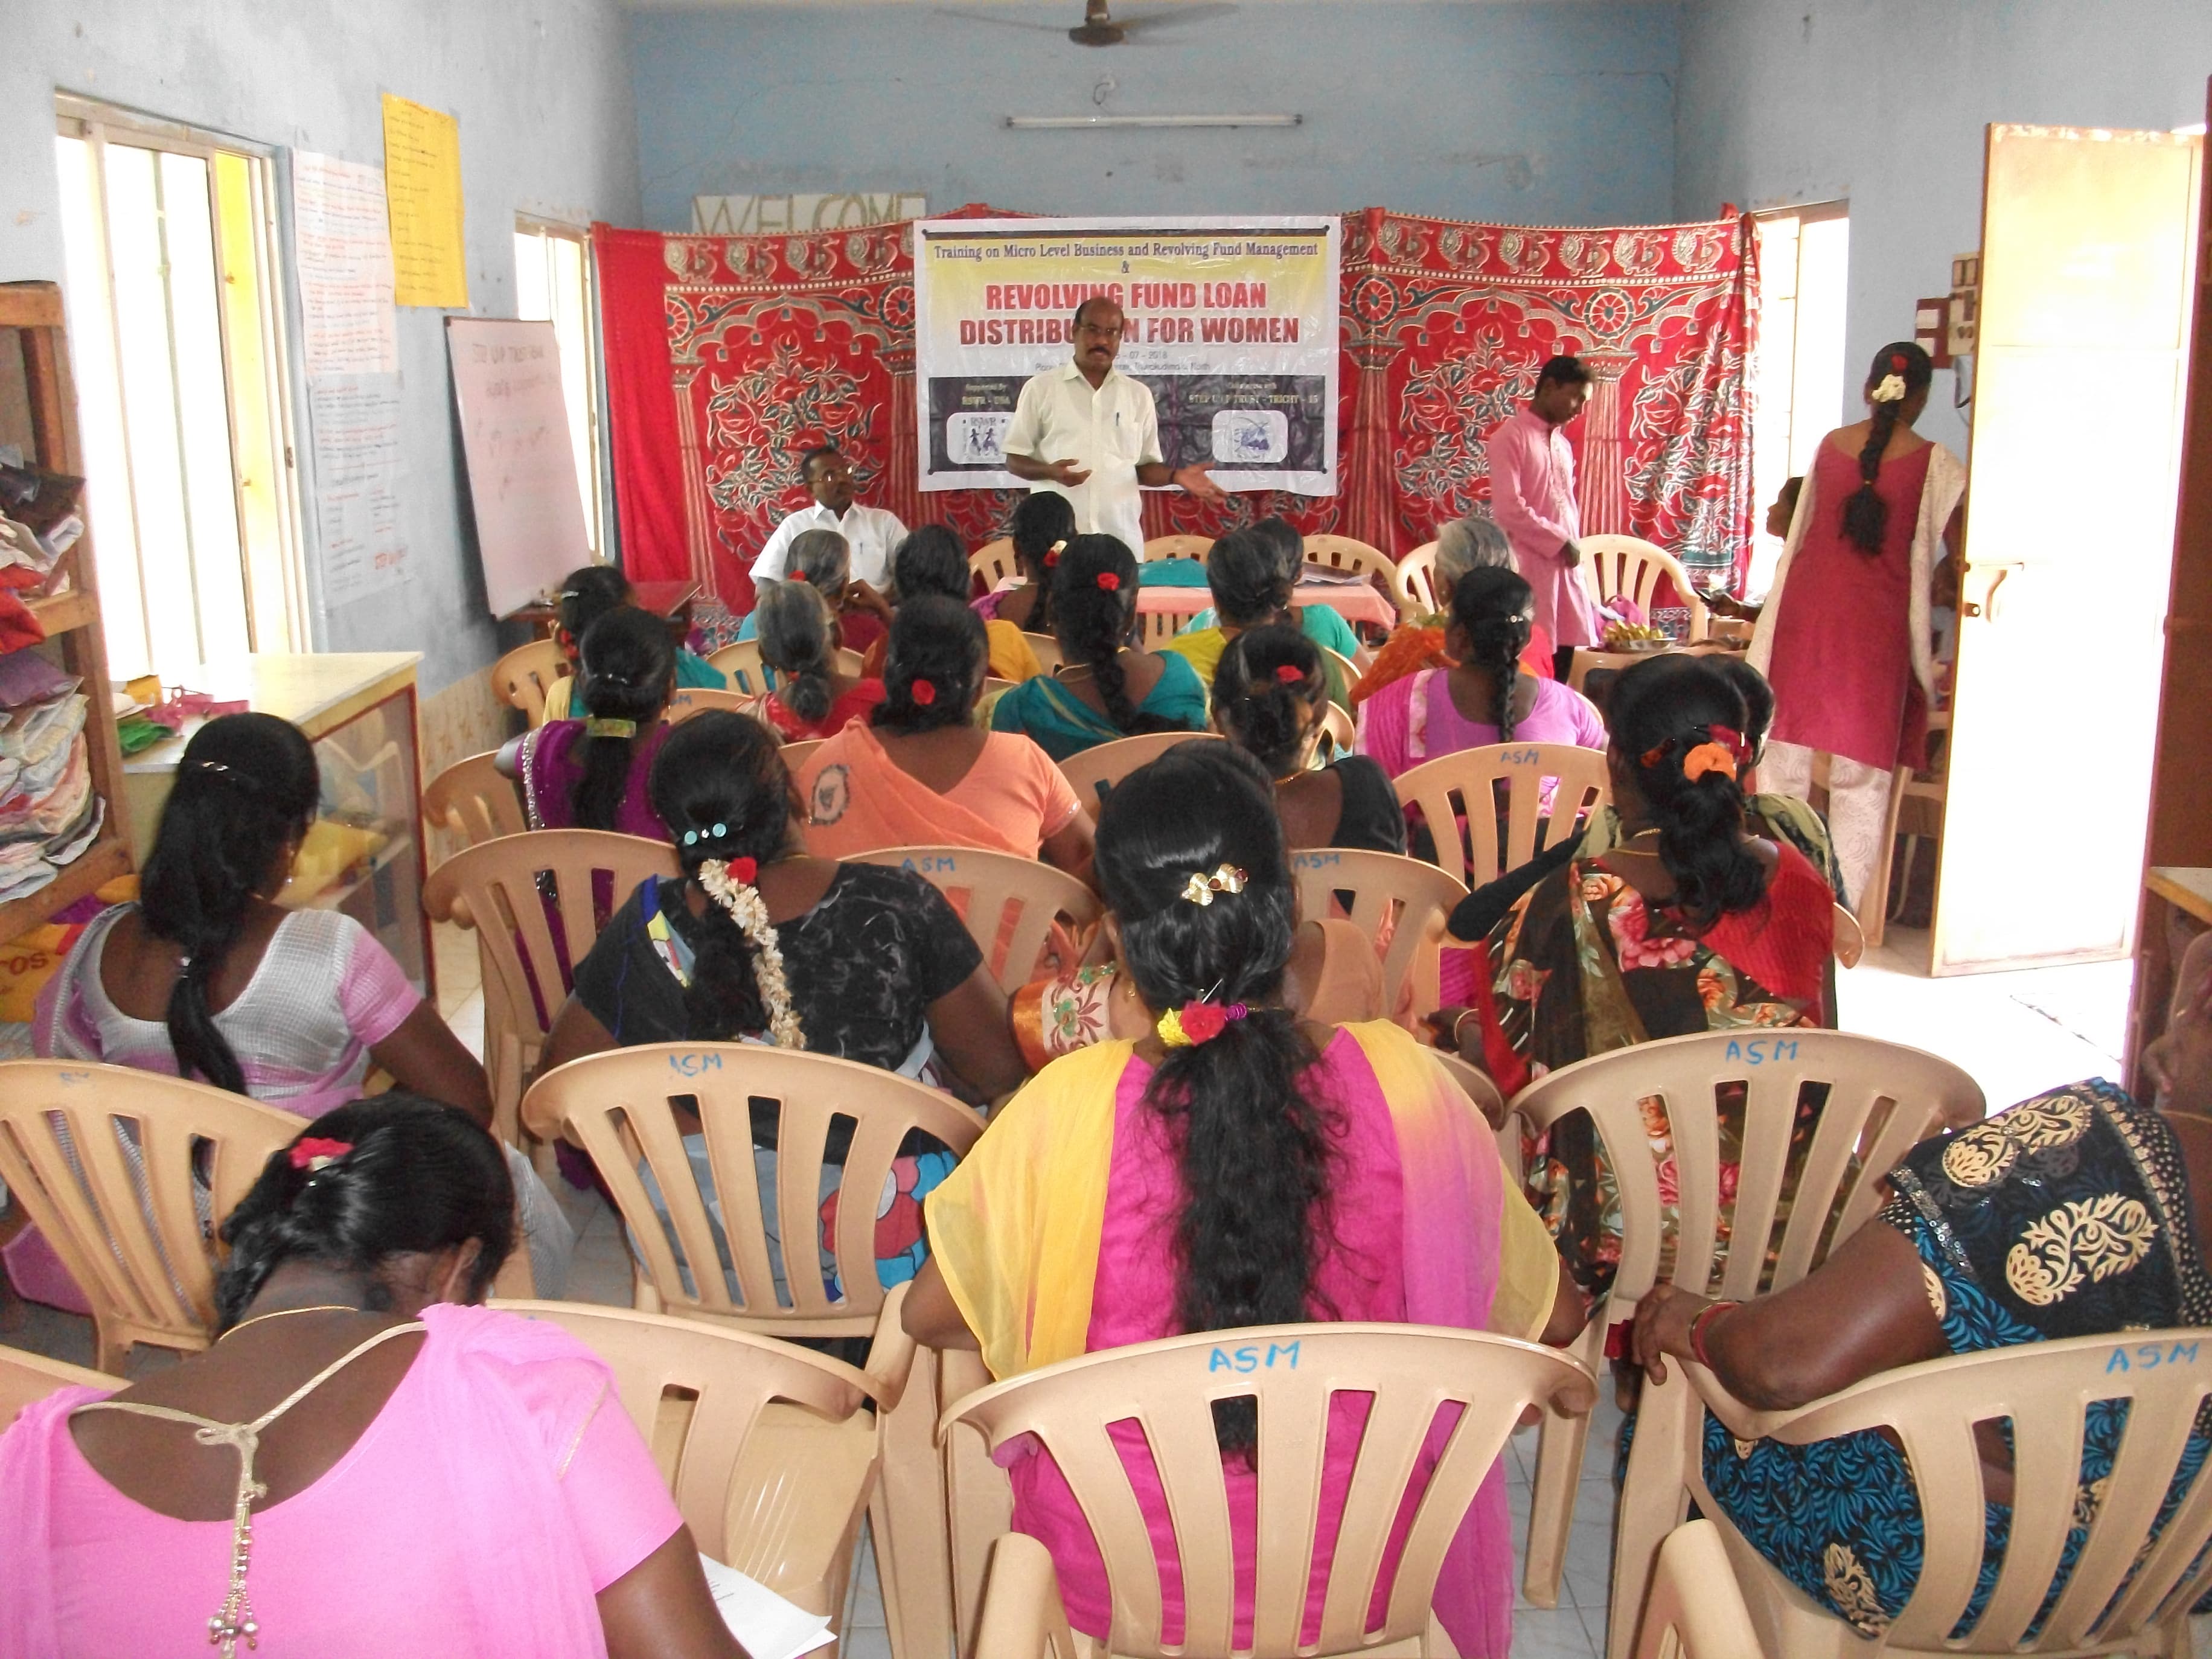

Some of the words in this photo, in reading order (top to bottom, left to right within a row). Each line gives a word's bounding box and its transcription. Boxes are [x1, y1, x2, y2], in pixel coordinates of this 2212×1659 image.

[935, 245, 982, 261] Training
[986, 248, 999, 257] on
[1003, 244, 1036, 258] Micro
[1040, 243, 1070, 257] Level
[1075, 243, 1124, 257] Business
[1128, 243, 1148, 256] and
[1153, 242, 1209, 260] Revolving
[1213, 242, 1241, 256] Fund
[1246, 242, 1318, 259] Management
[1121, 260, 1130, 273] &
[986, 283, 1124, 310] REVOLVING
[1131, 283, 1197, 308] FUND
[1203, 283, 1267, 308] LOAN
[960, 318, 1140, 345] DISTRIBUN
[1146, 317, 1194, 344] FOR
[1200, 317, 1299, 344] WOMEN
[1501, 749, 1538, 765] ASM
[901, 857, 956, 872] ASM
[1294, 853, 1340, 869] ASM
[1725, 1040, 1798, 1065] ASM
[1209, 1340, 1300, 1373] ASM
[2106, 1342, 2199, 1375] ASM
